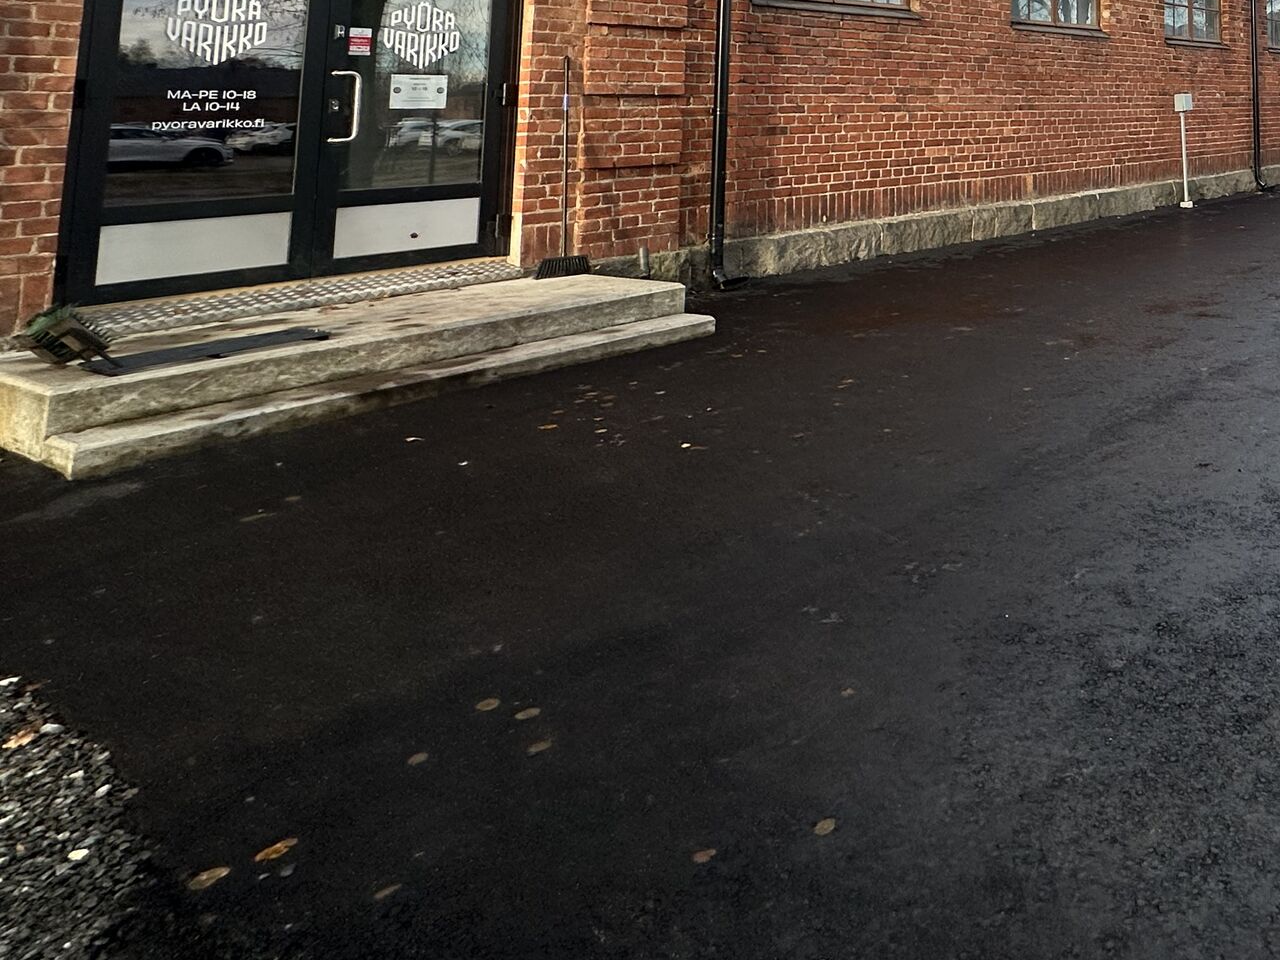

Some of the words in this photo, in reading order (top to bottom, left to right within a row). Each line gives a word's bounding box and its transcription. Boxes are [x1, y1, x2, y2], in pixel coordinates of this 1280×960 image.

[390, 1, 455, 32] PYÖRÄ
[166, 17, 267, 65] VARIKKO
[383, 27, 460, 69] VARIKKO
[167, 90, 219, 100] MA-PE
[222, 90, 257, 100] 10-18
[182, 102, 201, 111] LA
[205, 102, 240, 111] 10-14
[151, 119, 265, 131] pyoravarikko.fi
